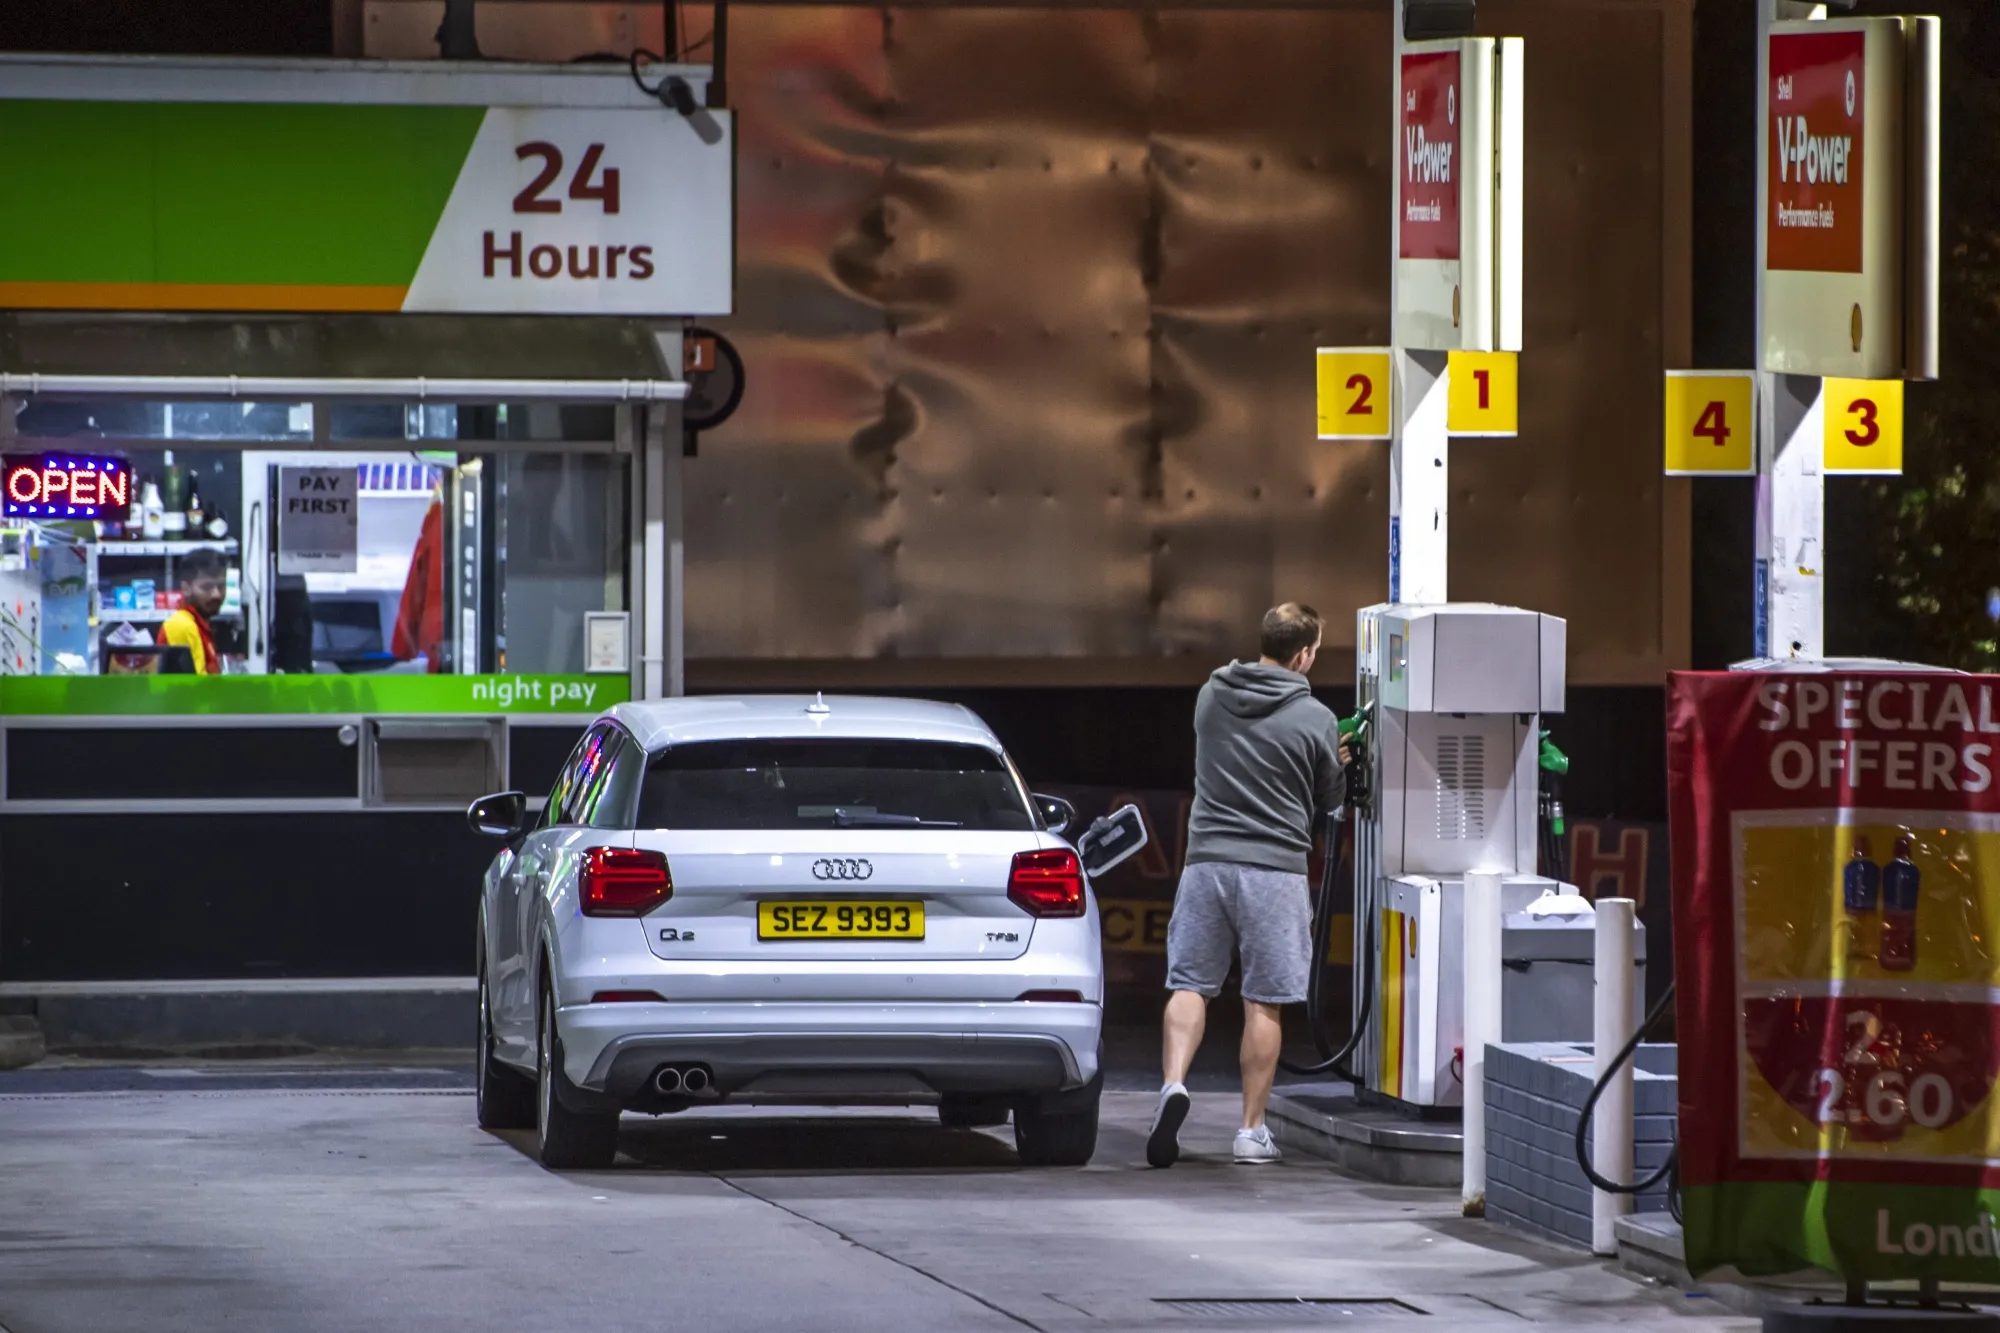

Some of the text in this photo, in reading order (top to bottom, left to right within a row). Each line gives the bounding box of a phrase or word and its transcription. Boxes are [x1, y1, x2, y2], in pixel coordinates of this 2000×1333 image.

[1777, 75, 1793, 101] Shell
[1406, 124, 1453, 184] V-Power
[1777, 115, 1852, 185] V-Power
[512, 141, 621, 215] 24
[1778, 200, 1834, 229] Performance Fuels
[482, 230, 655, 281] Hours
[1345, 373, 1373, 415] 2
[1473, 369, 1490, 409] 1
[1693, 401, 1731, 447] 4
[1844, 398, 1880, 447] 3
[9, 466, 127, 507] OPEN
[299, 476, 340, 491] PAY
[289, 498, 350, 514] FIRST
[472, 676, 597, 707] night pay
[1758, 680, 2000, 733] SPECIAL
[1770, 740, 1993, 793] OFFERS
[660, 928, 695, 941] Q2
[773, 906, 911, 932] SEZ 9393
[1877, 1207, 2000, 1259] Londi
